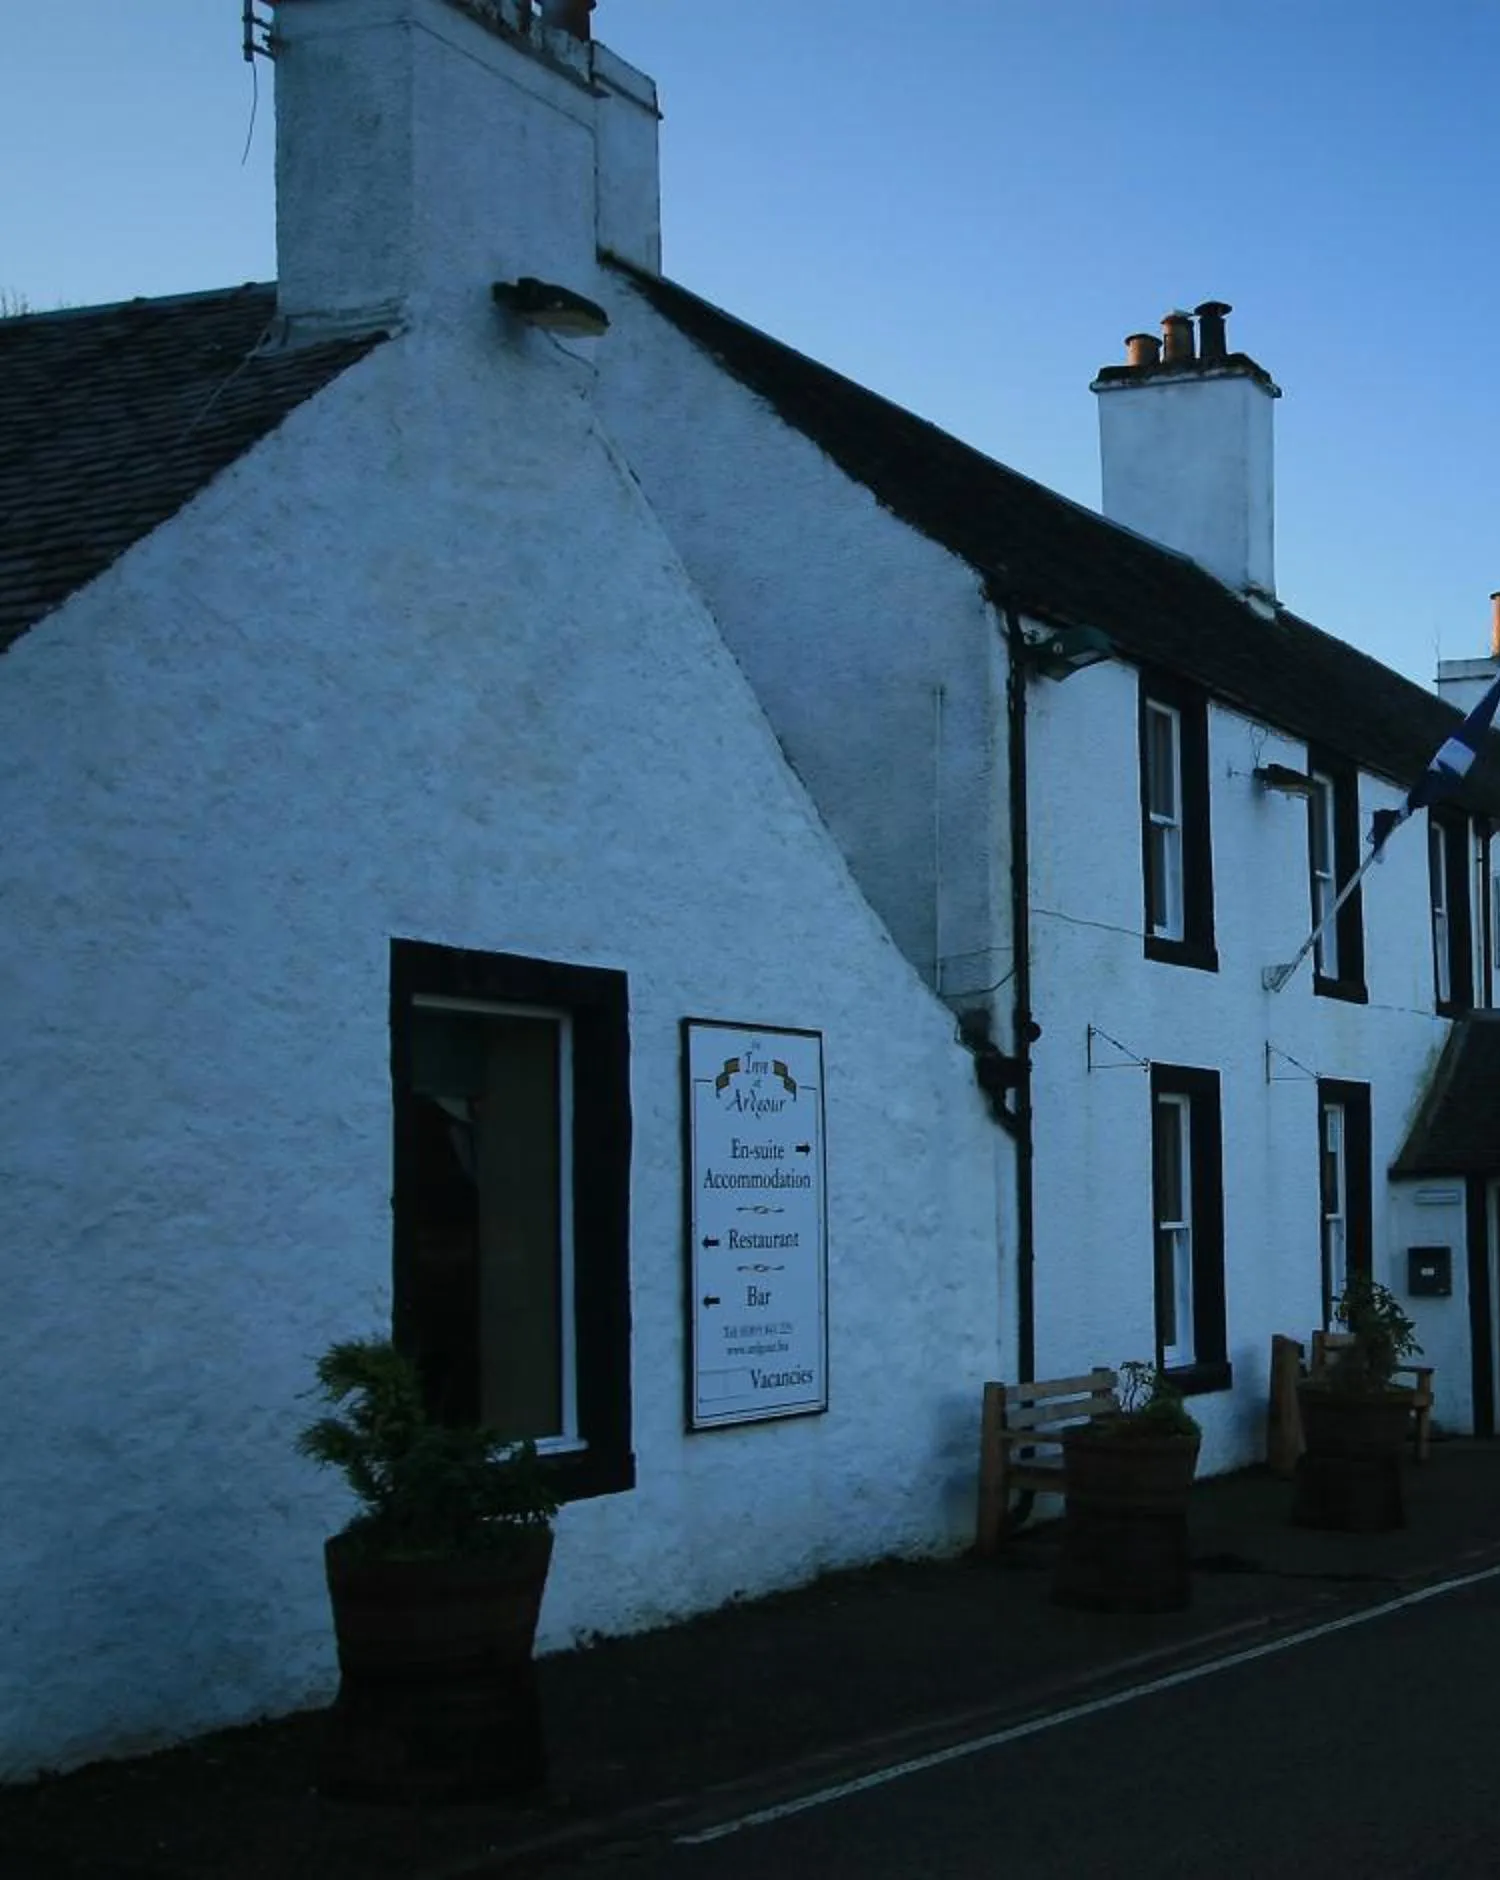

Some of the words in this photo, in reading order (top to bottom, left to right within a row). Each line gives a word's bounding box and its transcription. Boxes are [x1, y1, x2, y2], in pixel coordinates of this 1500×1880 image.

[744, 1050, 769, 1075] Inn
[730, 1138, 785, 1160] En-suite
[703, 1168, 811, 1189] Accommodation
[729, 1229, 799, 1250] Restaurant
[747, 1285, 772, 1307] Bar
[751, 1365, 814, 1389] Vacancies
